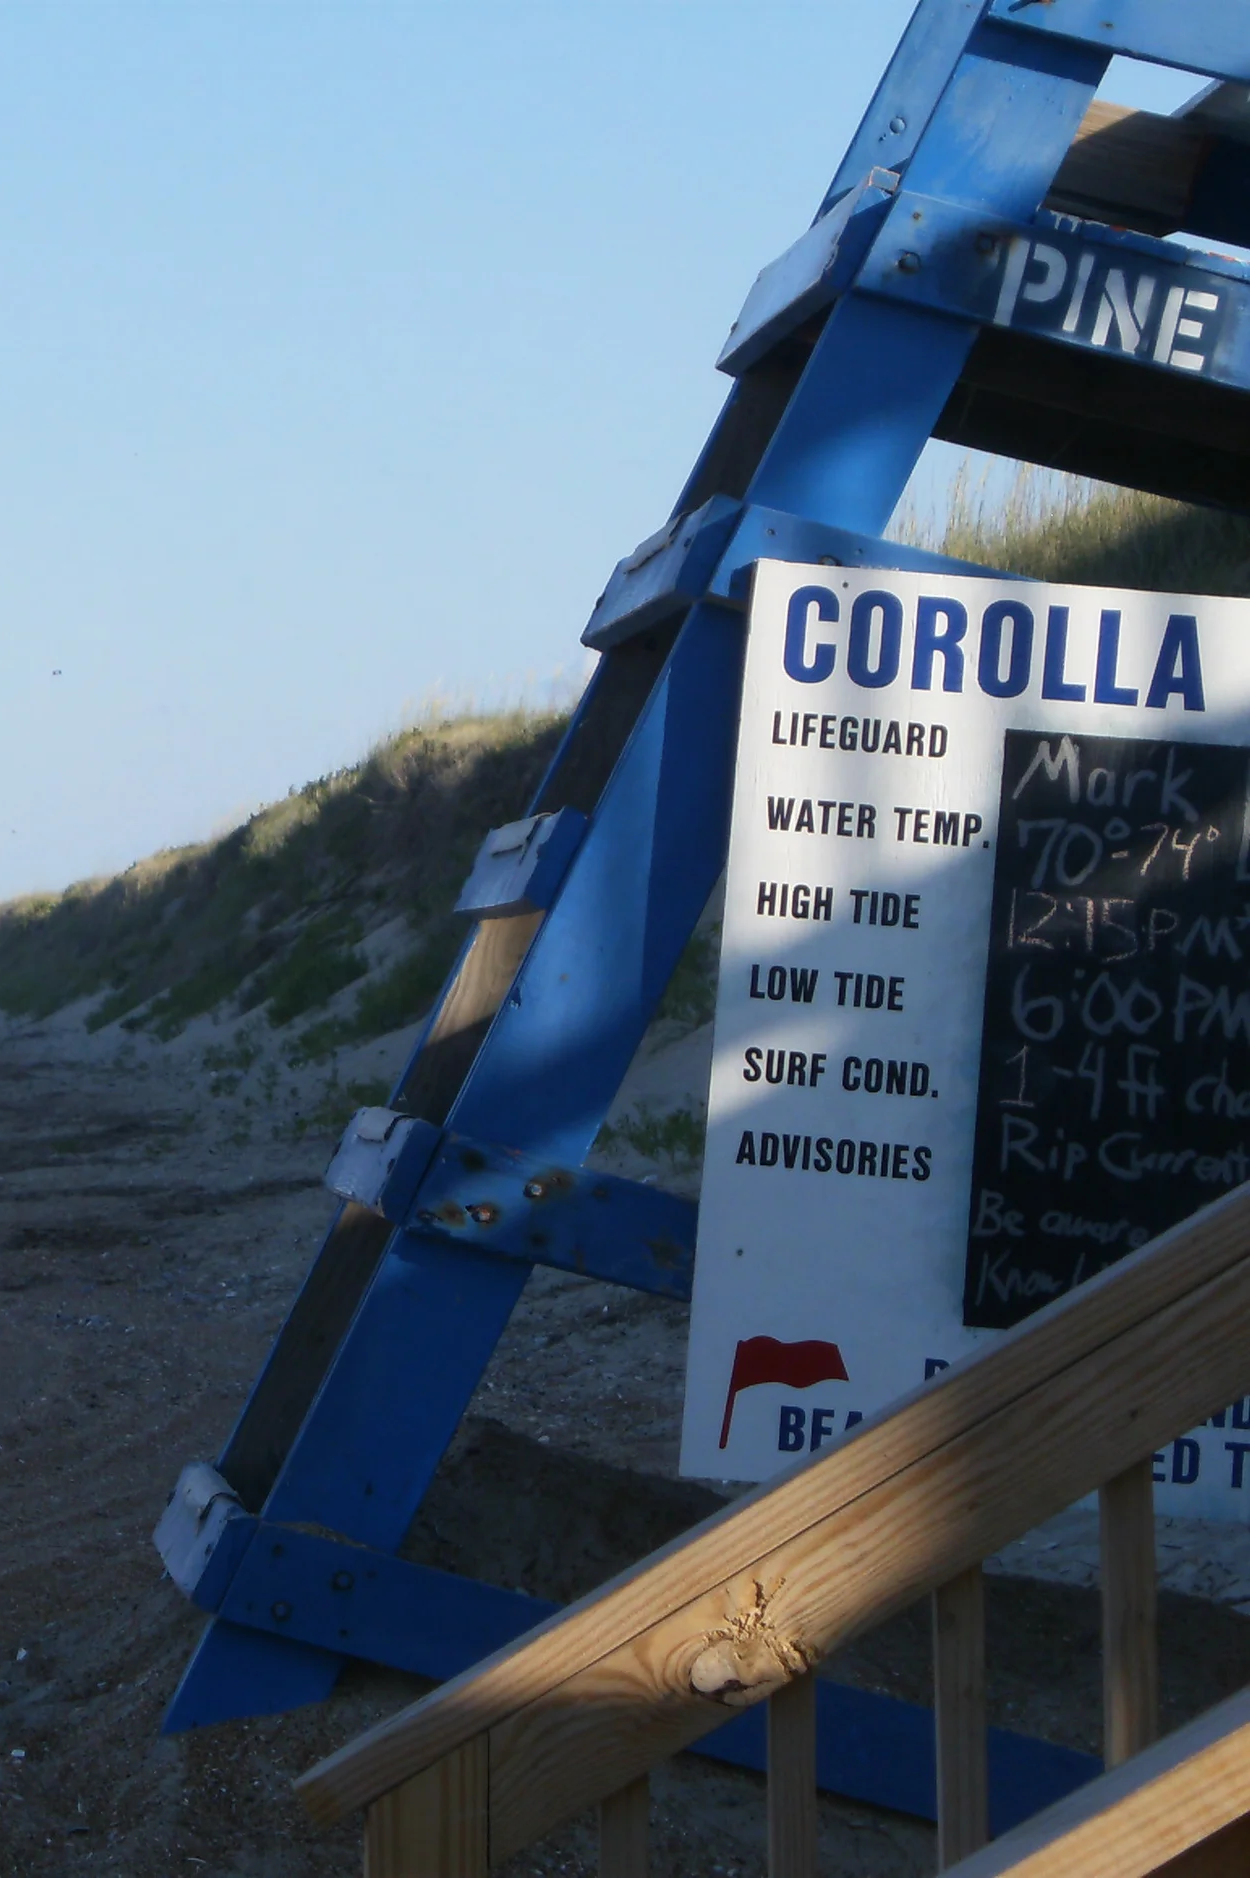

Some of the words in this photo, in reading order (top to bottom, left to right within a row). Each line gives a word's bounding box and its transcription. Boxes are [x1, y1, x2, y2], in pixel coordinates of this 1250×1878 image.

[993, 238, 1219, 371] PINE
[783, 584, 1206, 712] COROLLA
[772, 710, 949, 758] LIFEGUARD
[1011, 734, 1199, 823] Mark
[766, 795, 877, 839] WATER
[894, 807, 990, 849] TEMP.
[757, 881, 834, 922] HIGH
[850, 889, 921, 930] TIDE
[749, 964, 818, 1004] LOW
[833, 971, 905, 1012] TIDE
[742, 1047, 828, 1088] SURF
[842, 1056, 939, 1099] COND.
[735, 1131, 933, 1182] ADVISORIES
[1000, 1112, 1088, 1182] Rip
[972, 1187, 1025, 1238] Be
